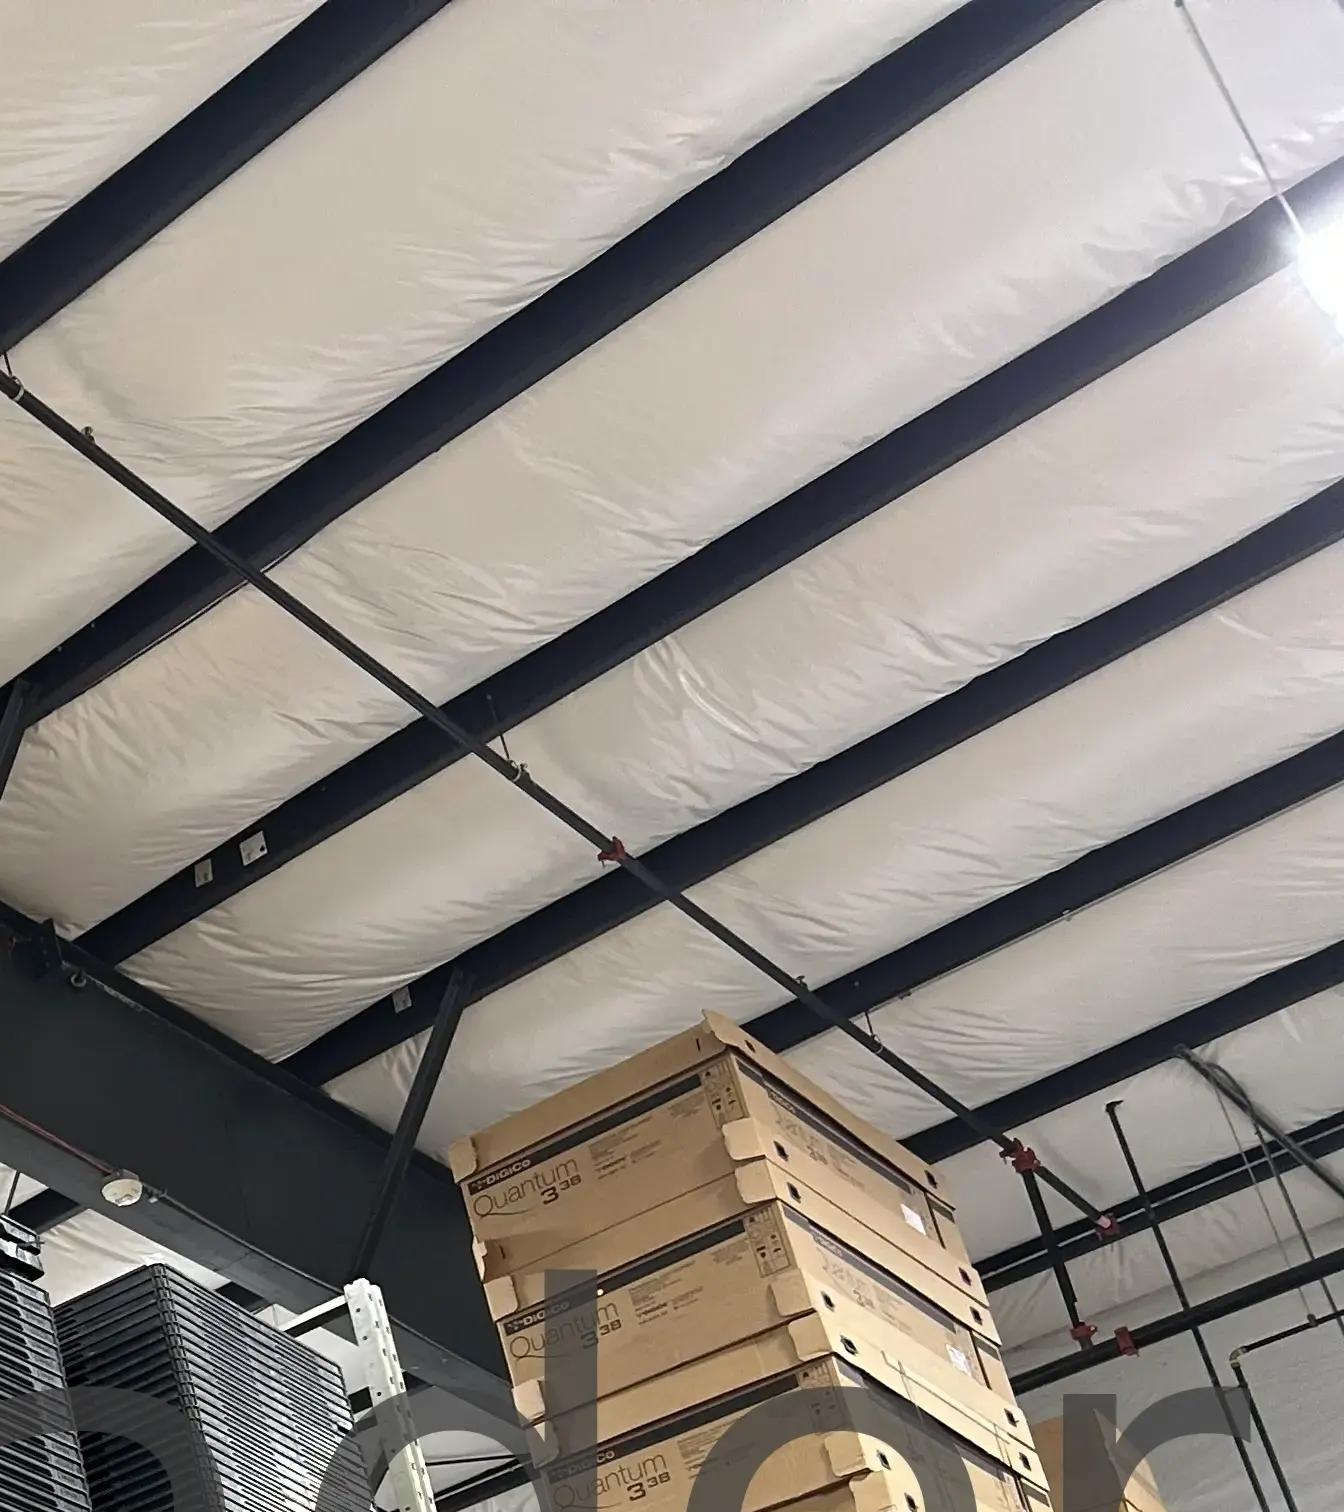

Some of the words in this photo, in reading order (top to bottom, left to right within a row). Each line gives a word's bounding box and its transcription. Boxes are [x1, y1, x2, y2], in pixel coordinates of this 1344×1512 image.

[472, 1157, 580, 1218] Quantum
[540, 1174, 582, 1205] 338
[509, 1301, 620, 1360] Quantum
[553, 1452, 668, 1509] Quantum
[626, 1471, 672, 1502] 338
